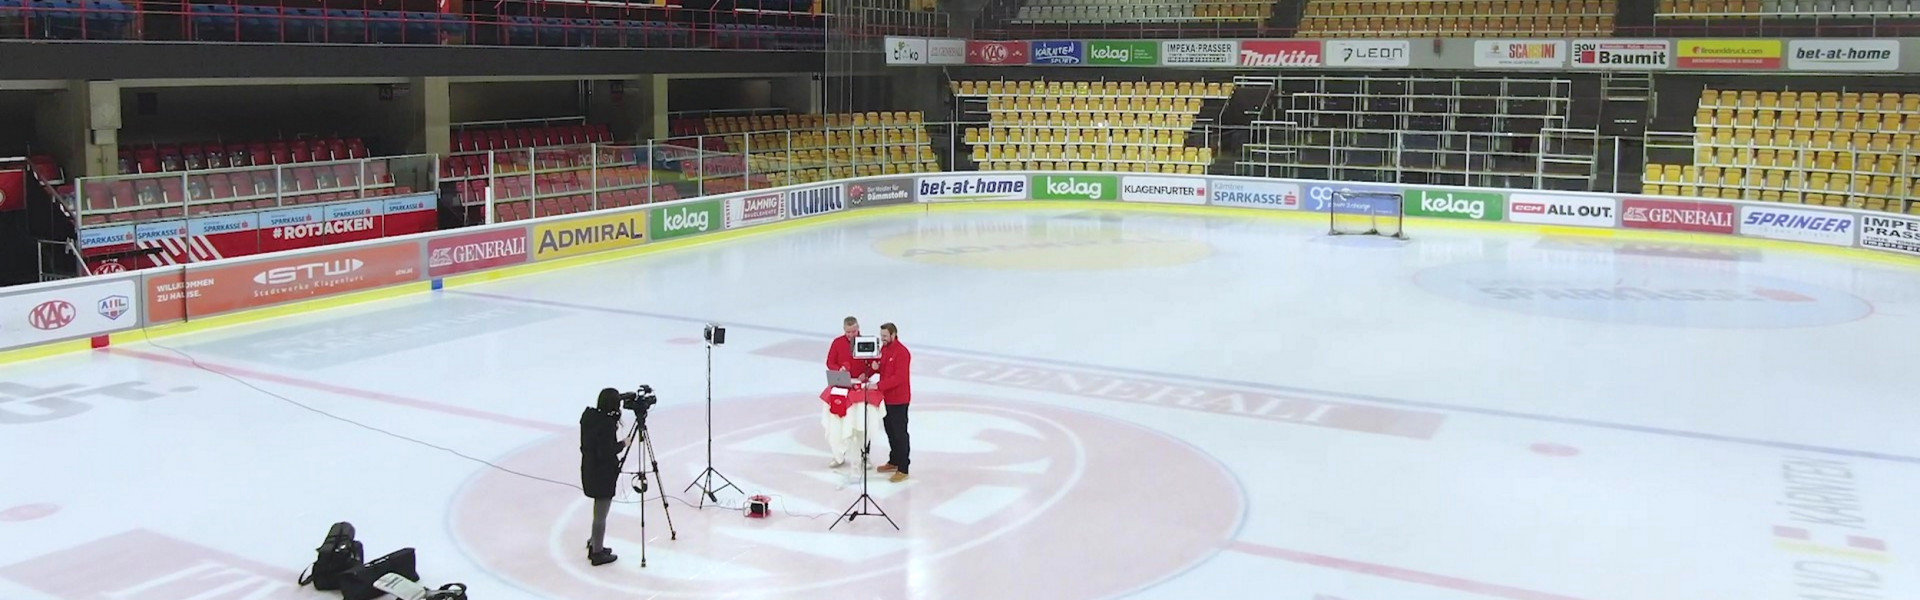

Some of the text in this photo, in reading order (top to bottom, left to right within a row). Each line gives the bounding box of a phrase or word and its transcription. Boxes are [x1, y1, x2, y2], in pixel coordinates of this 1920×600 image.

[983, 45, 1006, 61] KAC
[1091, 44, 1129, 62] kelag
[1599, 51, 1666, 65] Baumit
[1796, 48, 1891, 60] bet-at-home
[920, 178, 1024, 196] bet-at-home
[1047, 177, 1102, 199] kelag
[1124, 184, 1195, 196] KLAGENFURTER
[867, 190, 908, 201] Dämmstoffe
[1214, 191, 1282, 205] SPARKASSE
[744, 197, 778, 212] JAMNIG
[1421, 191, 1484, 218] kelag
[1547, 204, 1613, 218] ALL OUT.
[271, 215, 305, 226] SPARKASSE
[333, 208, 365, 218] SPARKASSE
[664, 207, 709, 232] kelag
[1649, 208, 1732, 227] GENERALI
[203, 222, 241, 233] SPARKASSE
[1744, 211, 1851, 233] SPRINGER
[81, 235, 124, 246] SPARKASSE
[137, 229, 177, 240] SPARKASSE
[538, 218, 643, 254] ADMIRAL
[453, 237, 527, 264] GENERALI
[268, 258, 350, 284] STW
[157, 278, 215, 293] WILLKOMMEN
[254, 284, 309, 298] Stadtwerke
[157, 294, 168, 302] ZU
[31, 301, 74, 330] KAC
[940, 361, 1339, 422] GENERALI
